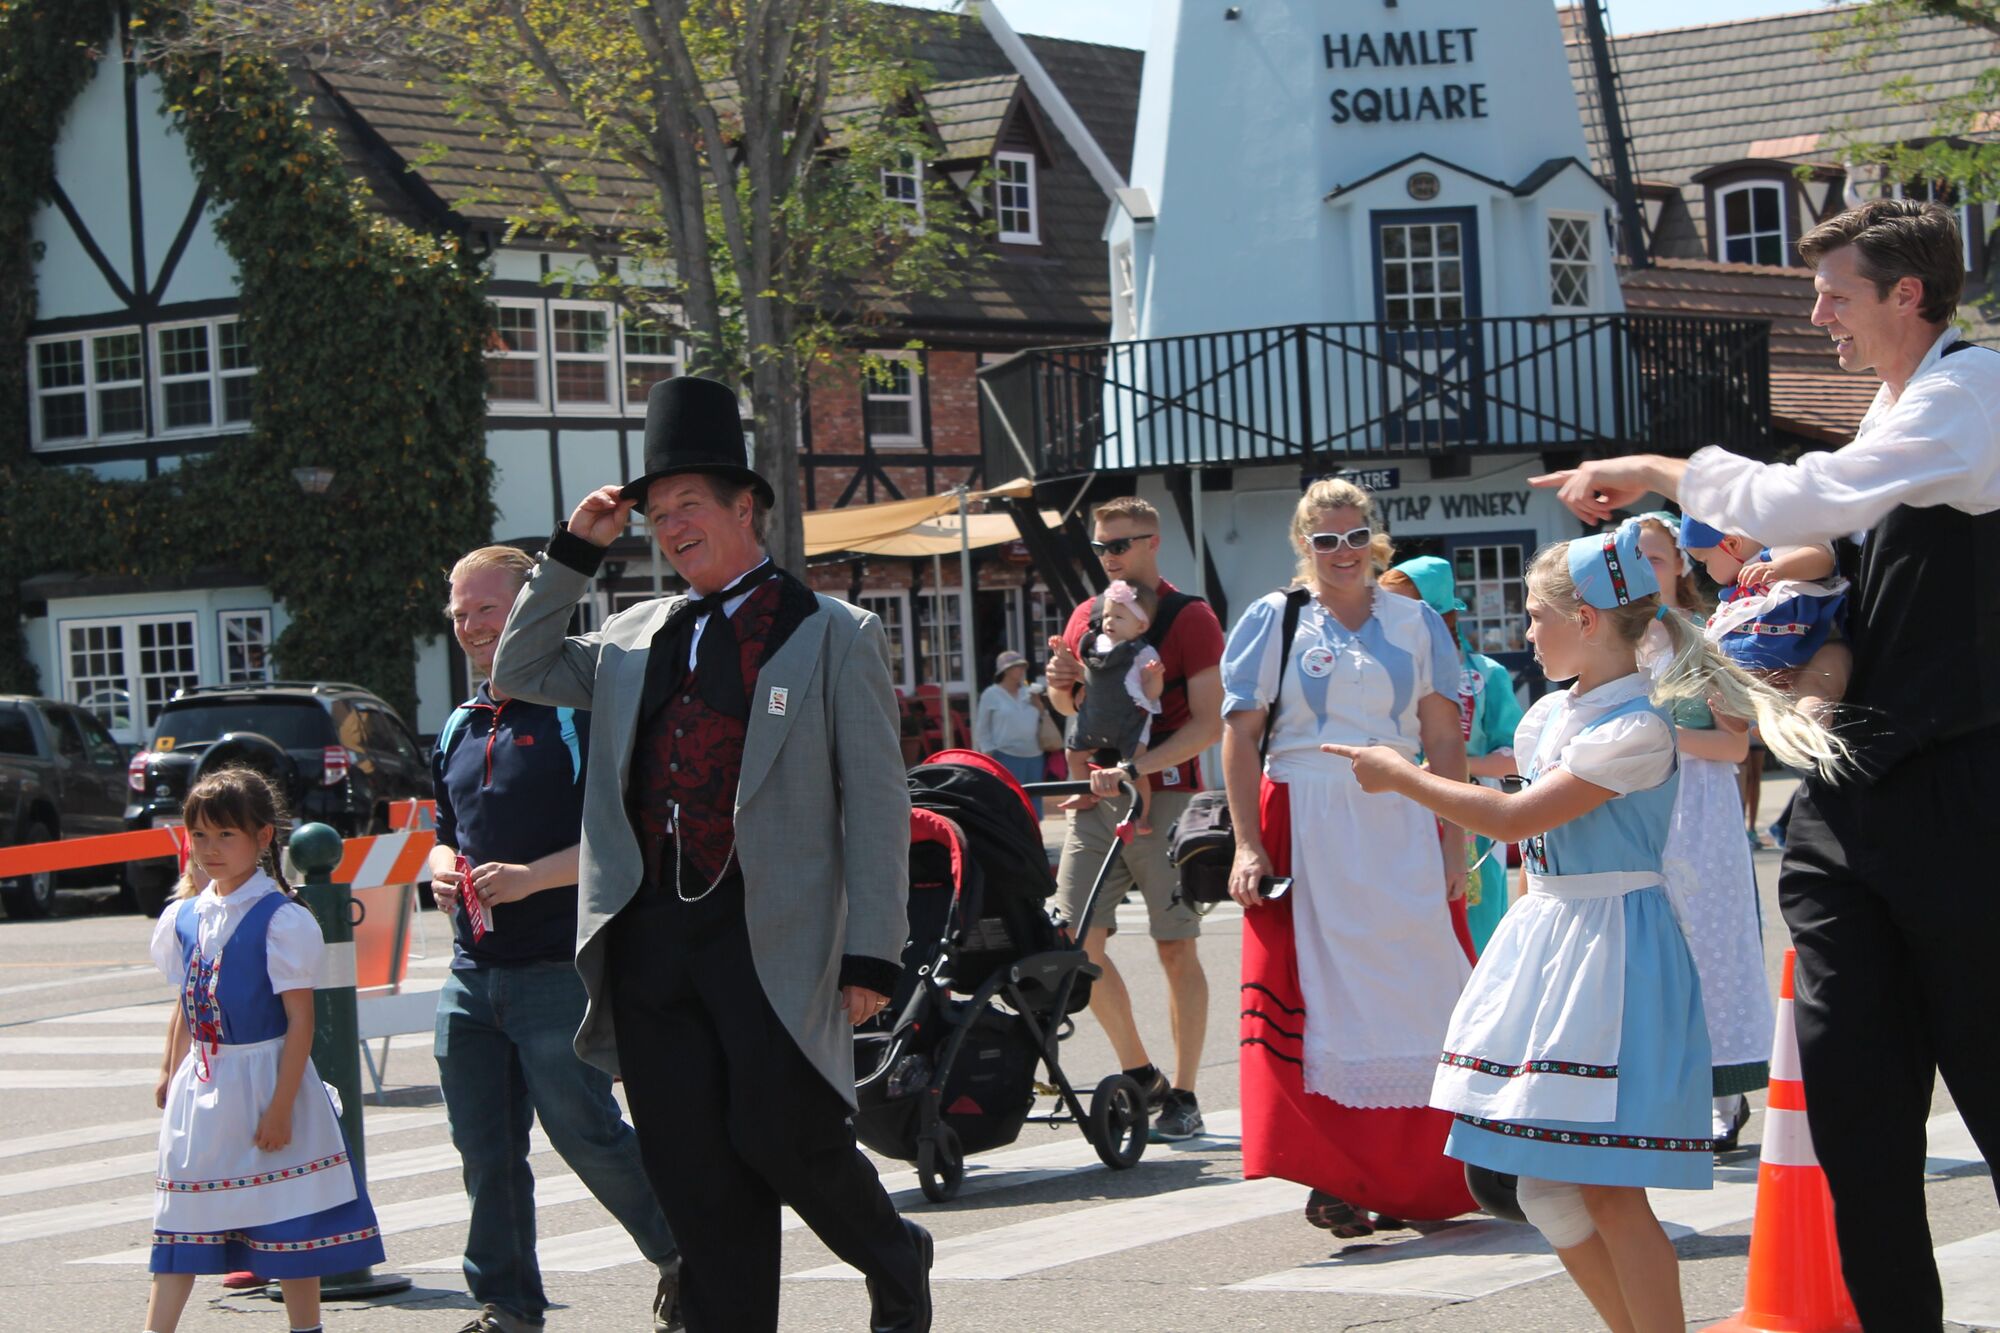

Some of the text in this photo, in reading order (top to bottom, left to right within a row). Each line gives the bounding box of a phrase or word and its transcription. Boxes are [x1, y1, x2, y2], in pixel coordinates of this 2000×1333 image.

[1322, 28, 1478, 69] HAMLET
[1329, 83, 1489, 124] SQUARE
[1439, 490, 1531, 519] WINERY
